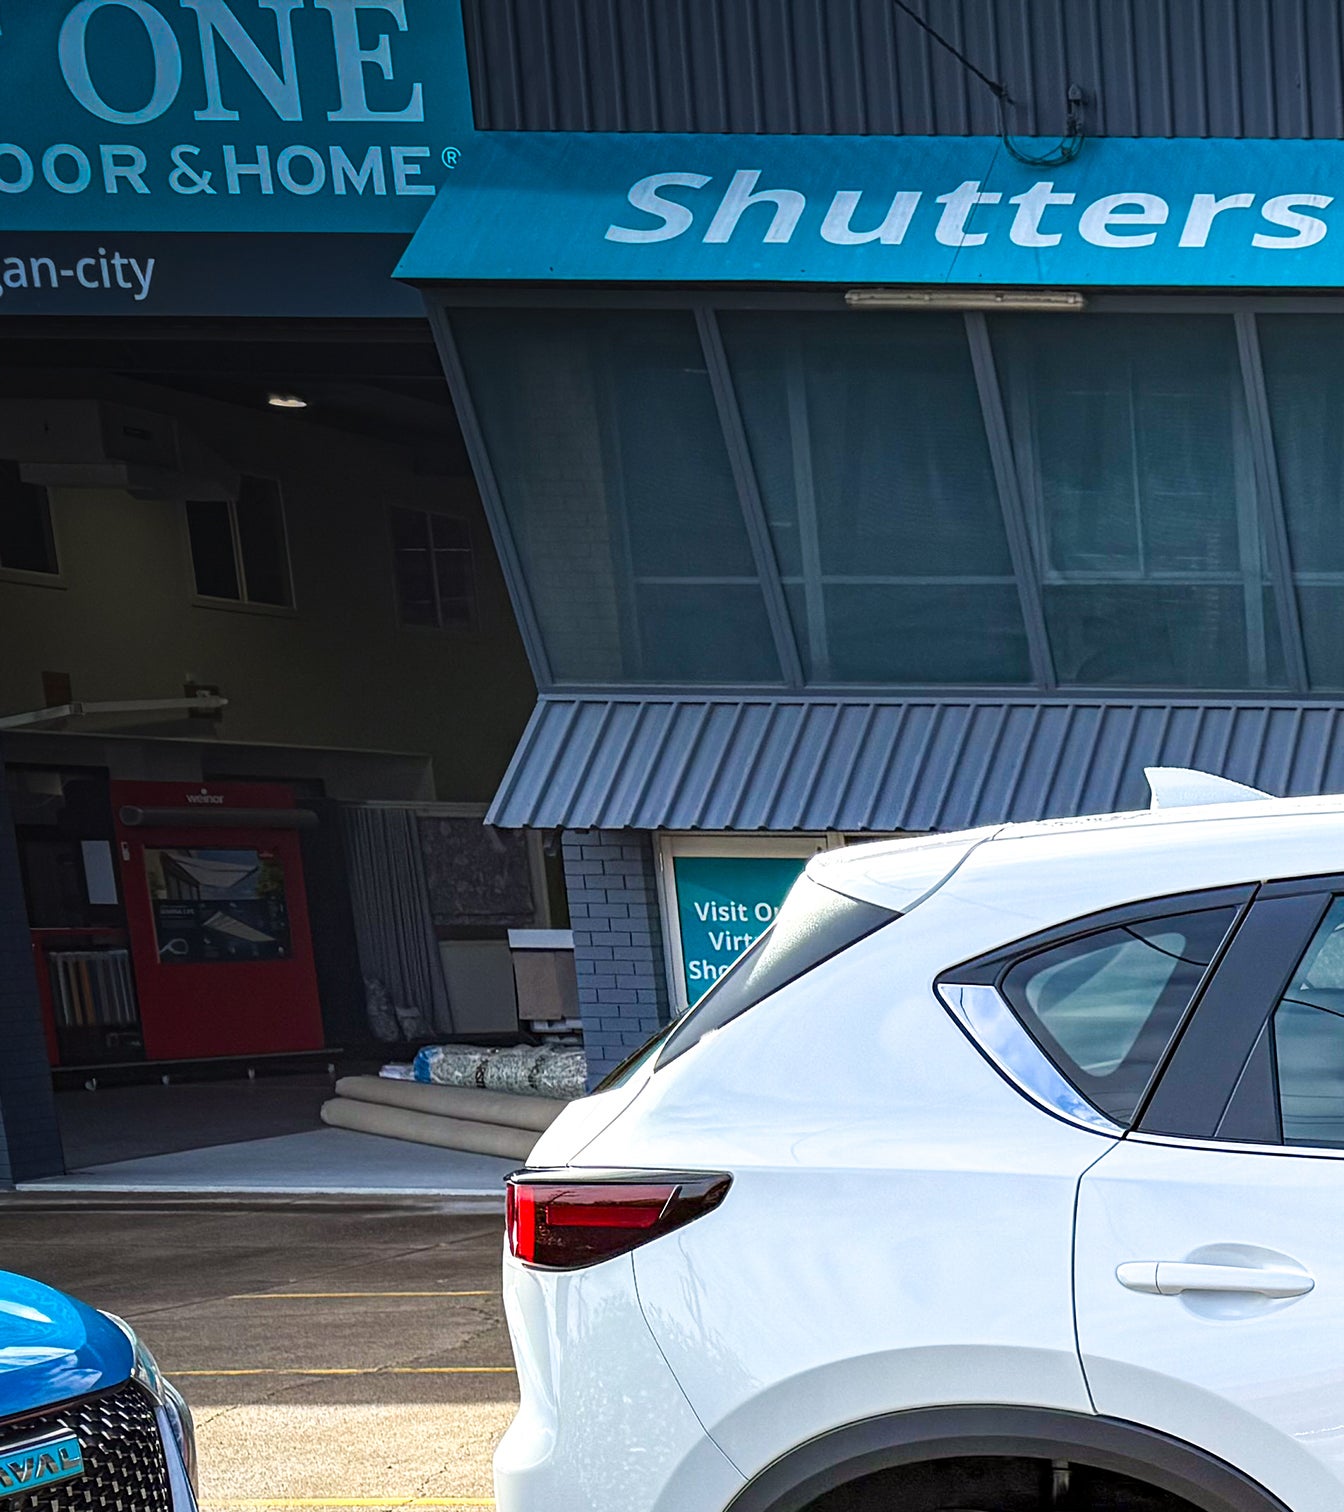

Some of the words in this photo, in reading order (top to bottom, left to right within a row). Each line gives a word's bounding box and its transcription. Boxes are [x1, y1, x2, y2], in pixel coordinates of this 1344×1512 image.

[58, 0, 425, 124] ONE
[168, 145, 217, 195] &
[604, 169, 1335, 249] Shutters
[0, 248, 155, 300] an-city
[694, 901, 748, 922] Visit
